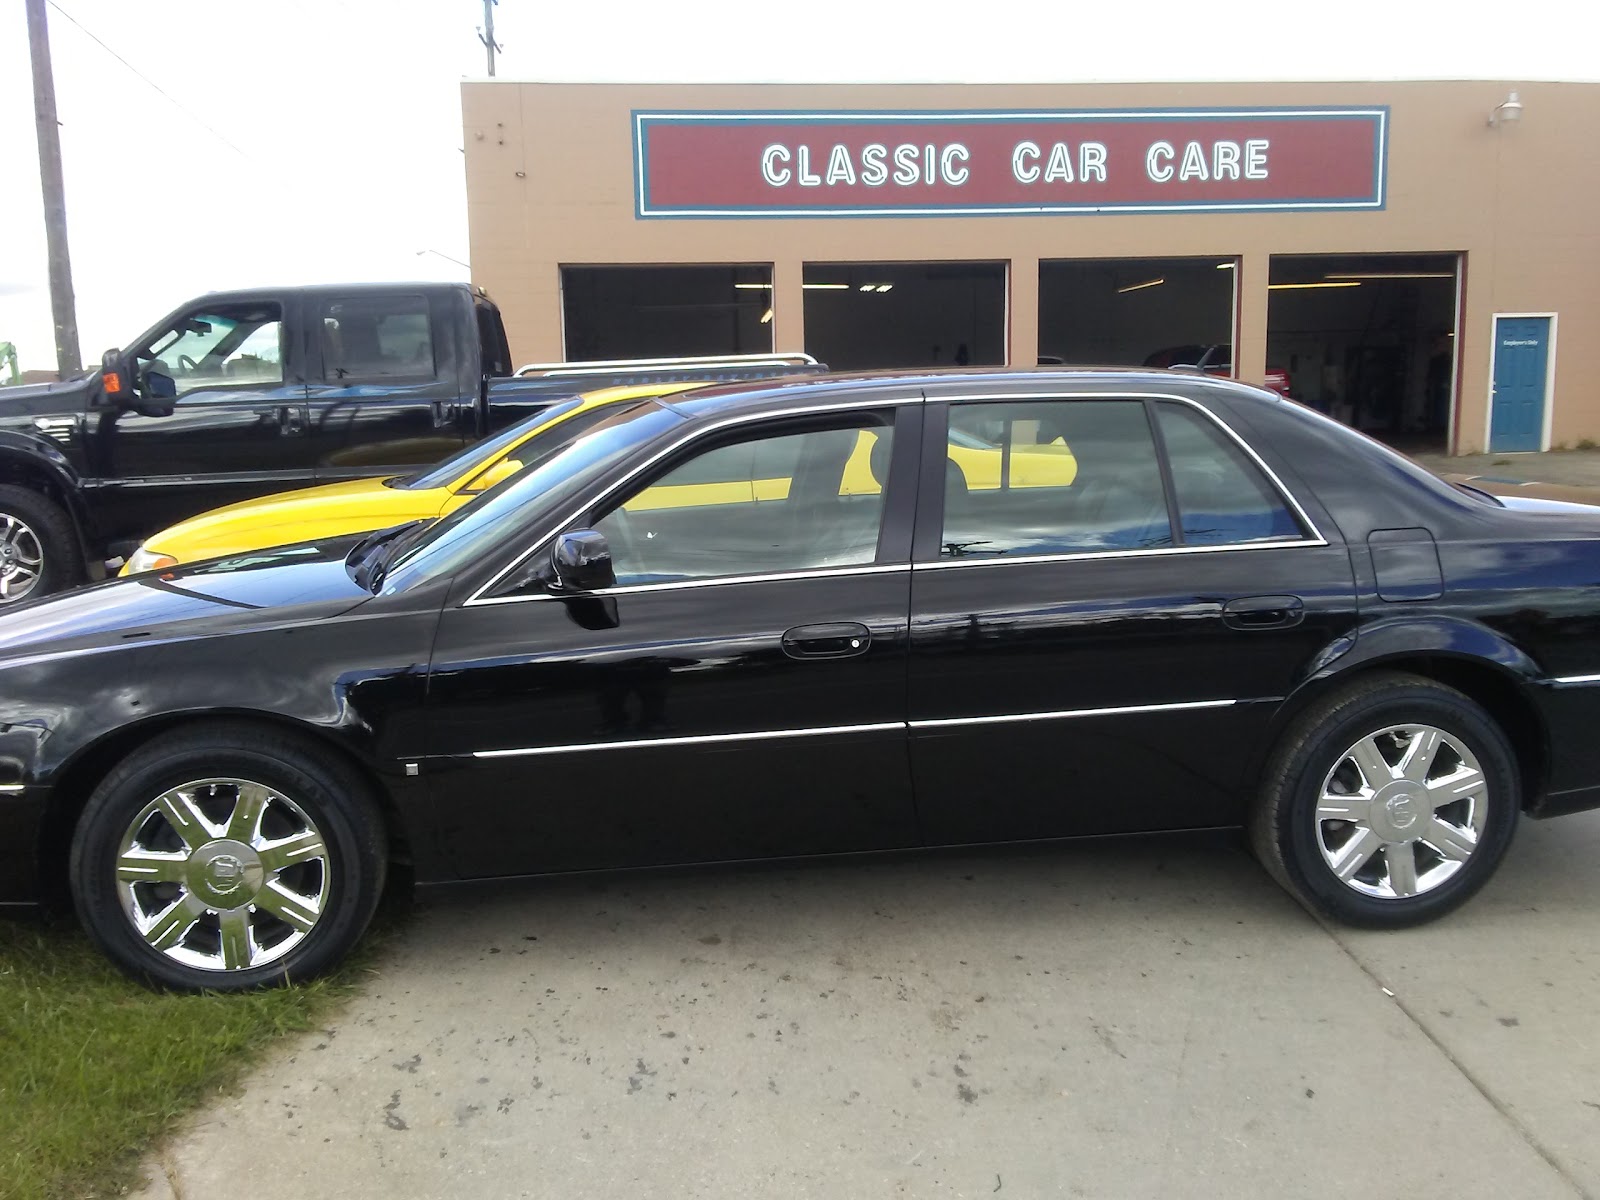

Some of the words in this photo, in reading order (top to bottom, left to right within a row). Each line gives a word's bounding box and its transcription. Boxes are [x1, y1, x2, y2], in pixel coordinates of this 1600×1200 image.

[760, 142, 972, 187] CLASSIC
[1011, 139, 1109, 184] CAR
[1144, 137, 1271, 183] CARE
